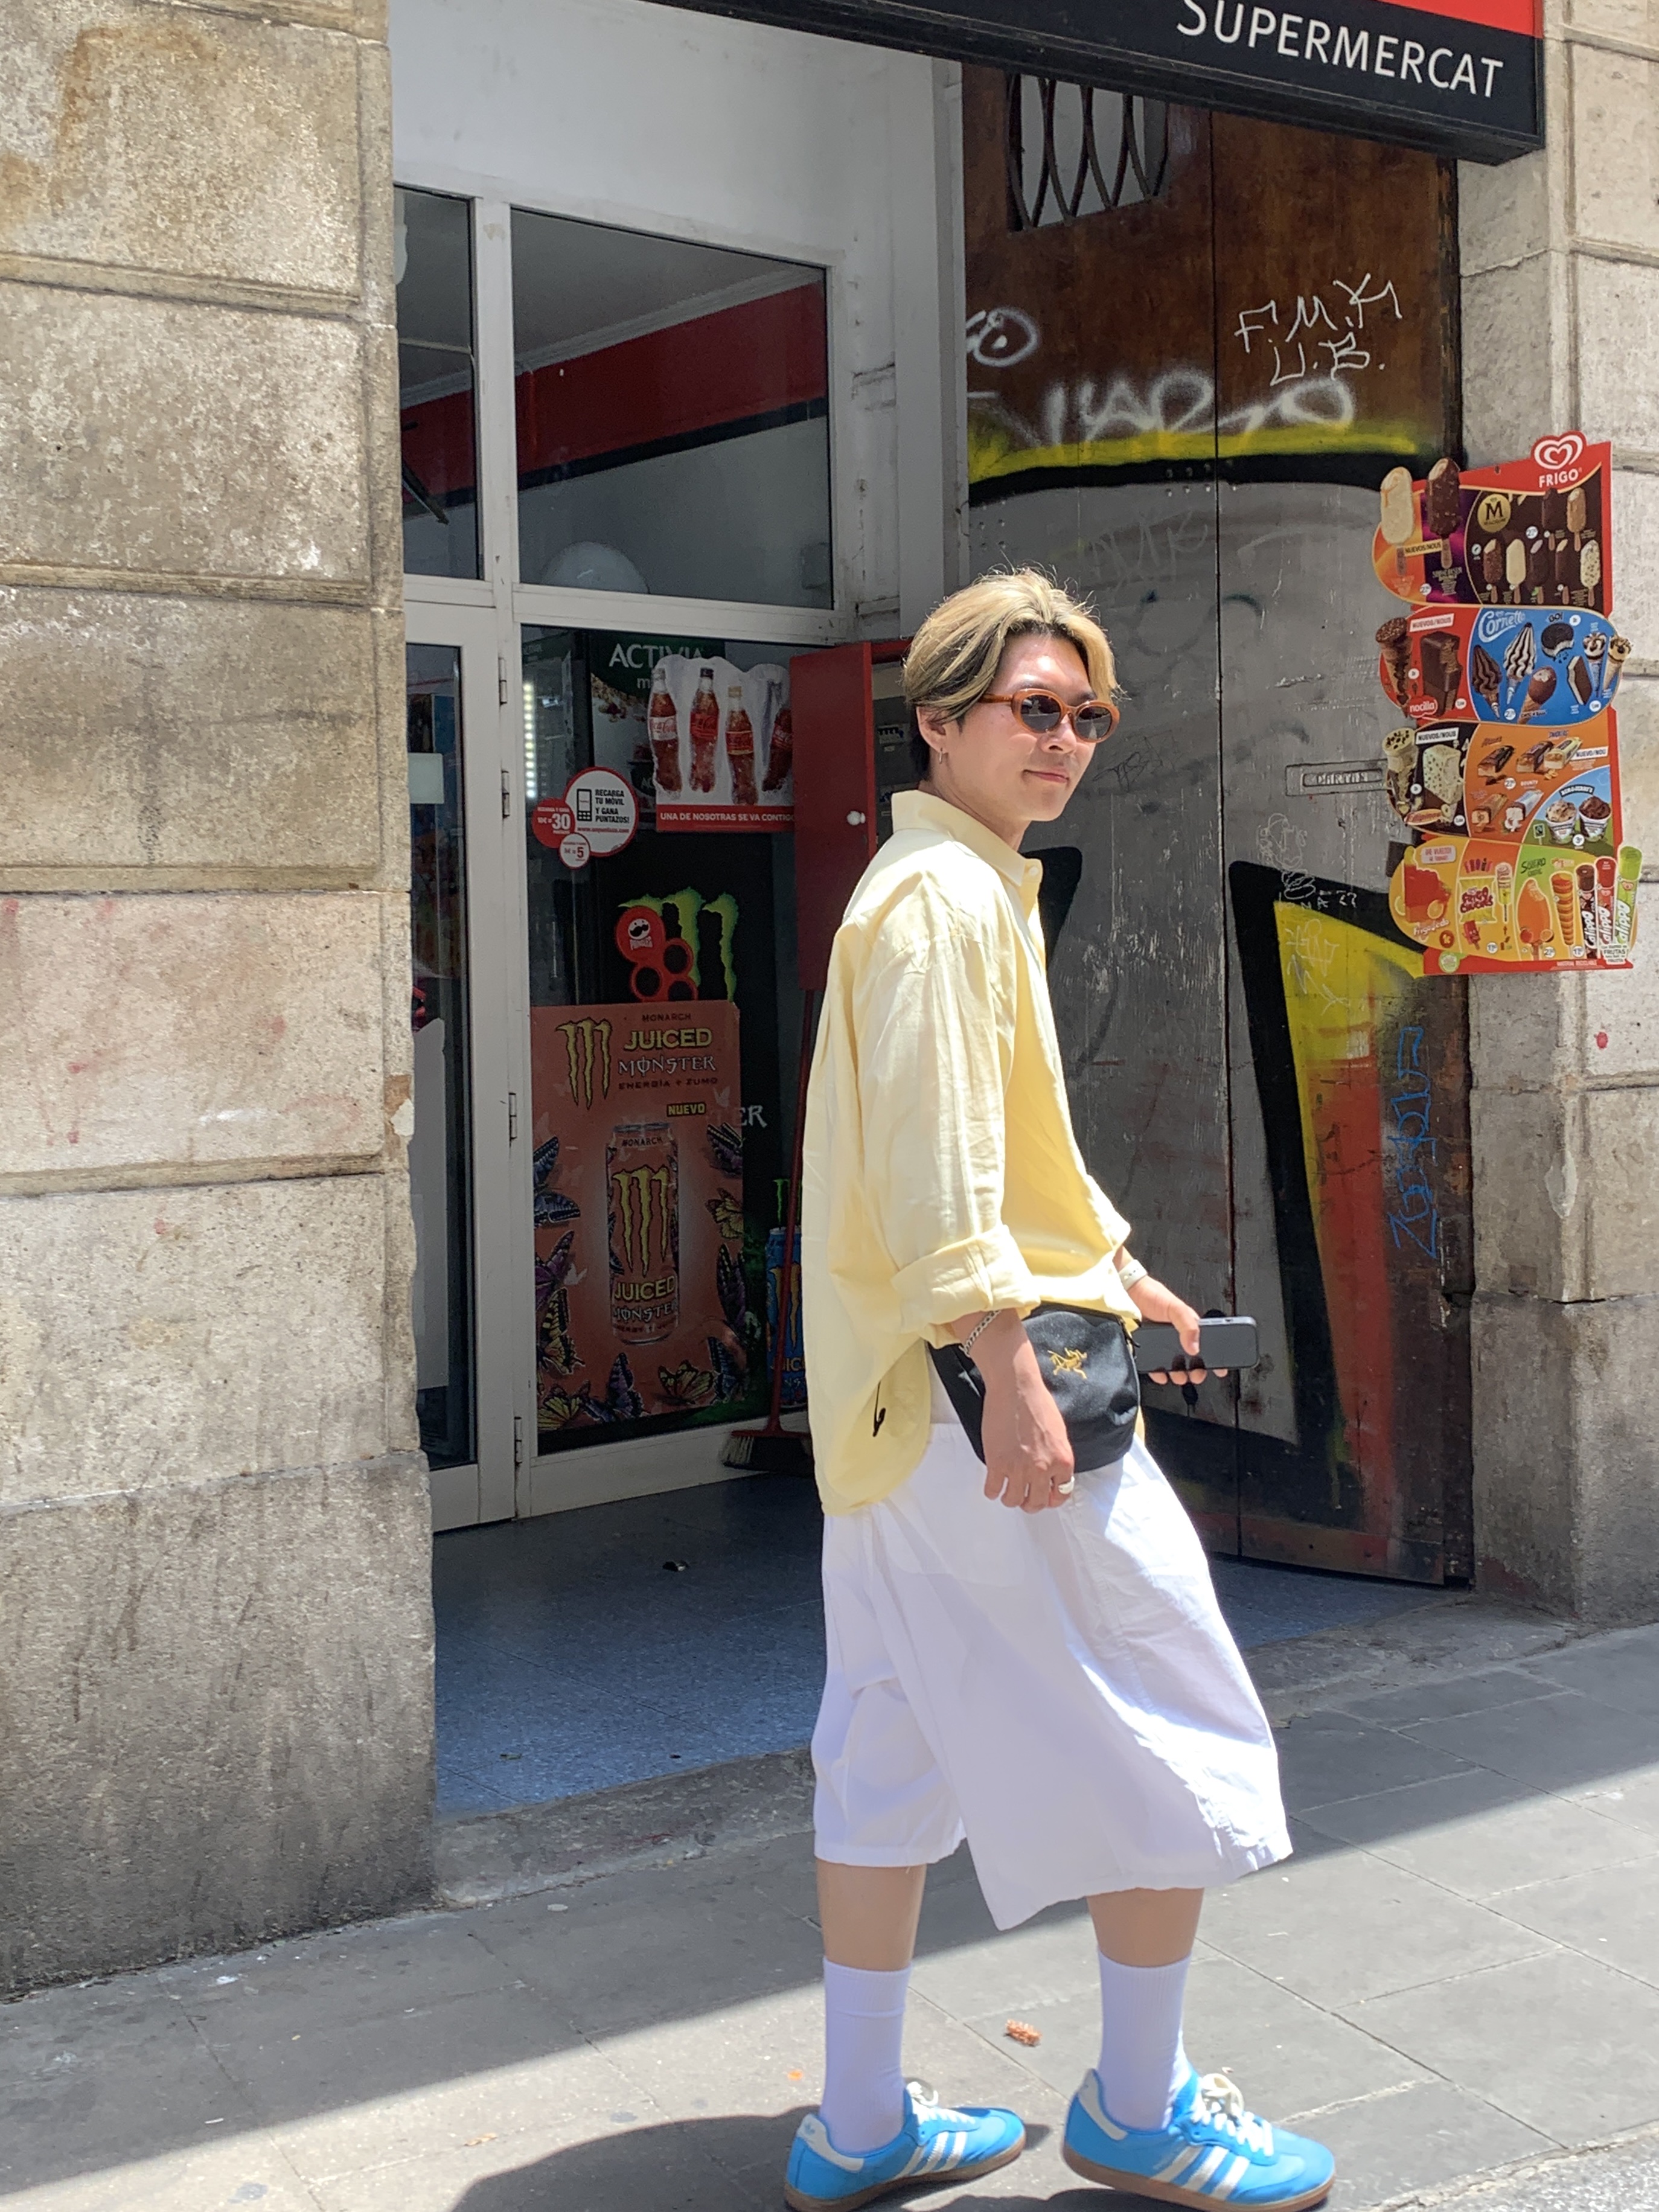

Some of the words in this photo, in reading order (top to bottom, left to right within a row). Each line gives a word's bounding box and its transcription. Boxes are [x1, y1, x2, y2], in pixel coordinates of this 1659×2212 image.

[1177, 0, 1504, 97] SUPERMERCAT
[1539, 469, 1579, 488] FRIGO
[1485, 500, 1503, 521] M
[1478, 610, 1526, 642] Cornetto
[1410, 701, 1435, 713] nocilla
[1418, 730, 1457, 741] NUEVOS/NOUS
[1576, 749, 1606, 758] NUEVO/NOU
[595, 789, 625, 798] RECARGA
[552, 813, 571, 830] 30
[660, 812, 679, 820] UNA
[692, 812, 736, 821] NOSOTRAS
[738, 813, 748, 821] SE
[749, 813, 761, 821] VA
[577, 846, 584, 858] 5
[1582, 910, 1596, 949] Calippo
[642, 1013, 691, 1021] MONARCH
[623, 1028, 713, 1051] JUICED
[668, 1103, 705, 1115] NUEVO
[622, 1137, 662, 1146] MONARCH
[614, 1275, 675, 1302] JUICED
